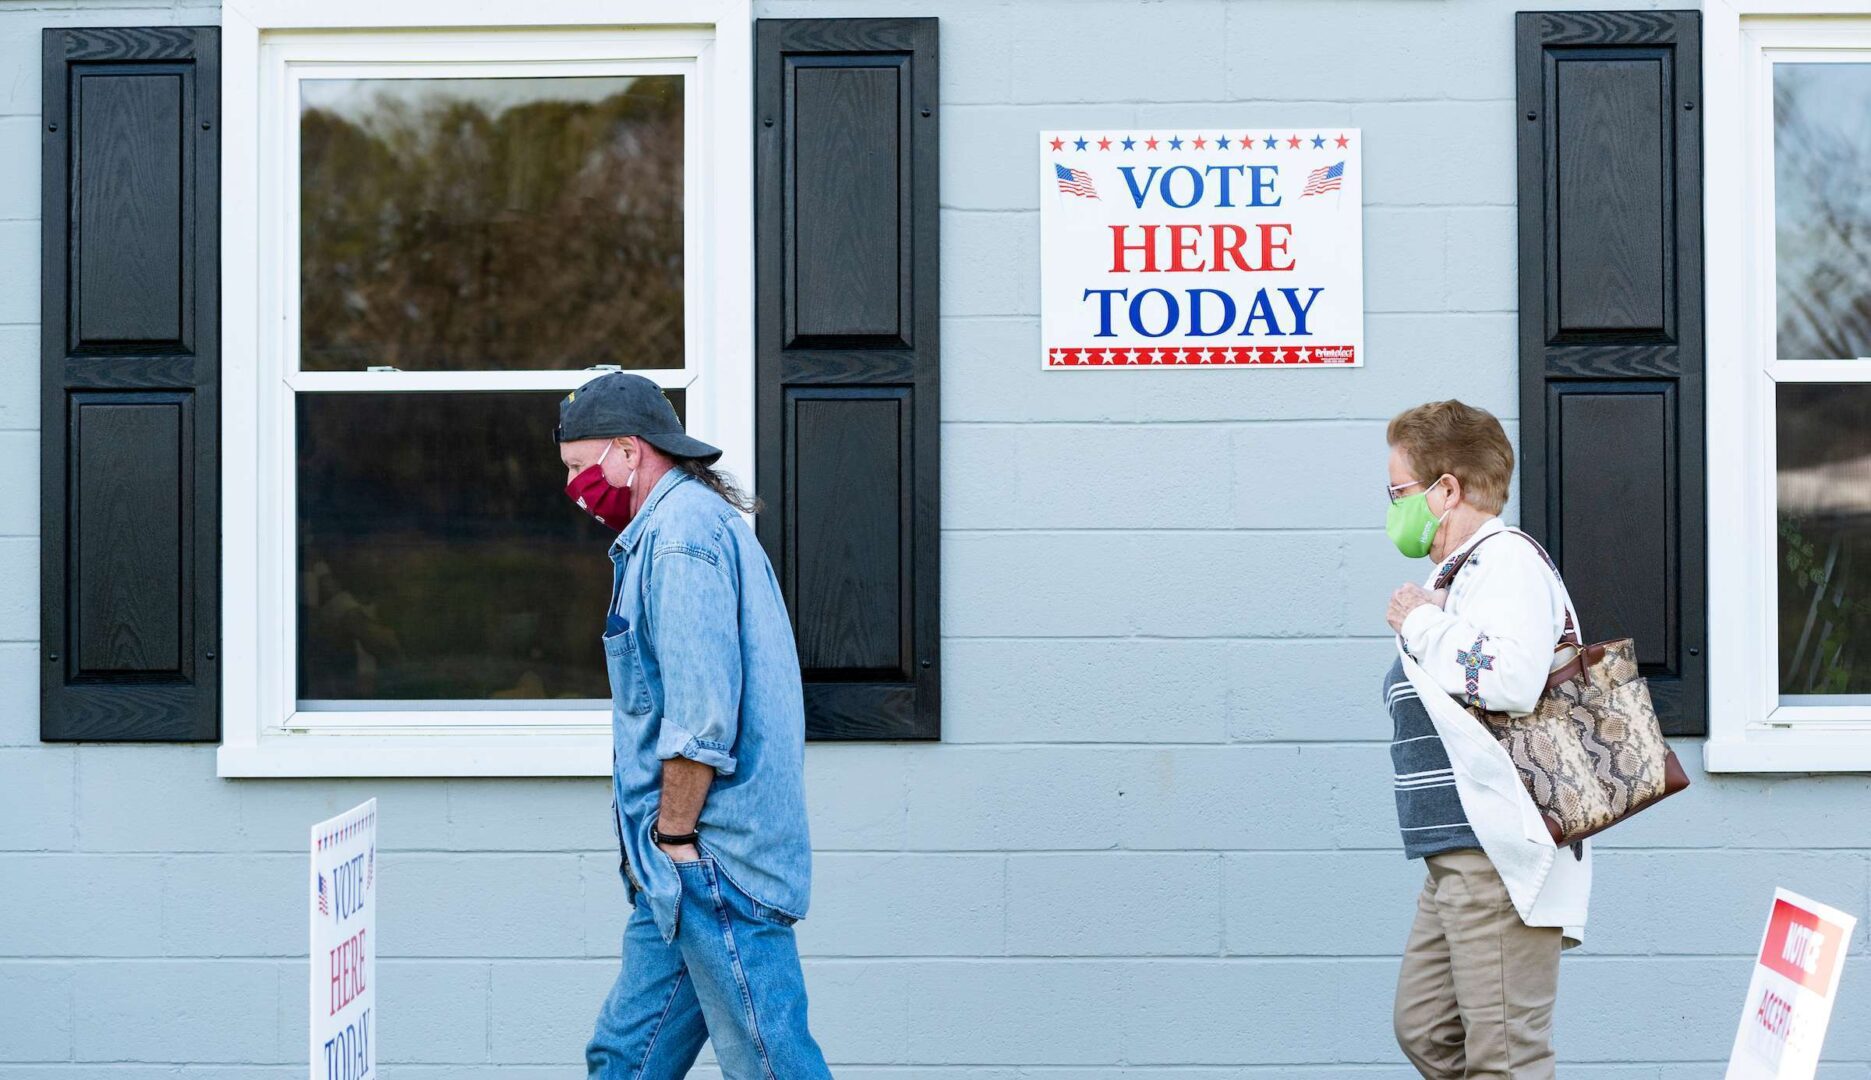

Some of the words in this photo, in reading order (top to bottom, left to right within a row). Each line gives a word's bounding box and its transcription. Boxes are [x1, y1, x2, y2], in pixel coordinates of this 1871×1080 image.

[1116, 164, 1283, 209] VOTE
[1107, 223, 1296, 273] HERE
[1082, 287, 1325, 338] TODAY
[332, 853, 365, 925] VOTE
[329, 928, 366, 1017] HERE
[324, 1007, 371, 1080] TODAY
